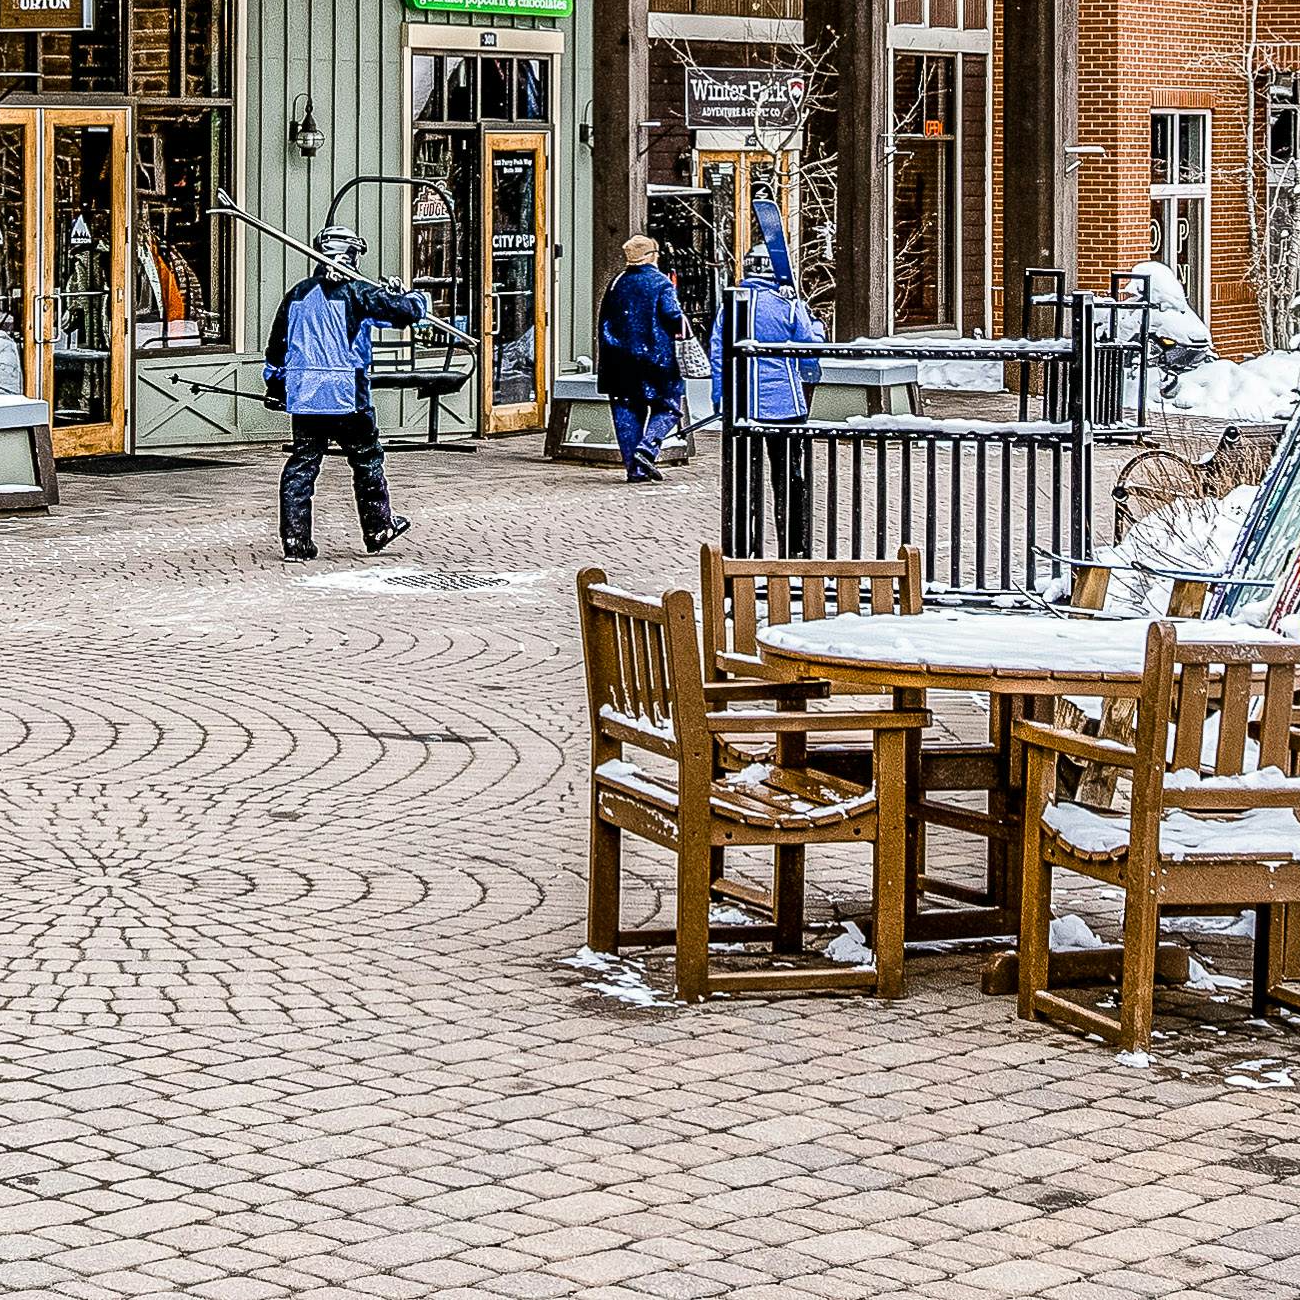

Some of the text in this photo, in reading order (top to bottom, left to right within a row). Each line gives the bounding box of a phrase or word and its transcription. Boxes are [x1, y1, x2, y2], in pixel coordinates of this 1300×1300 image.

[690, 79, 747, 102] Winter
[702, 106, 741, 117] ADVENTURE
[492, 234, 515, 248] CITY
